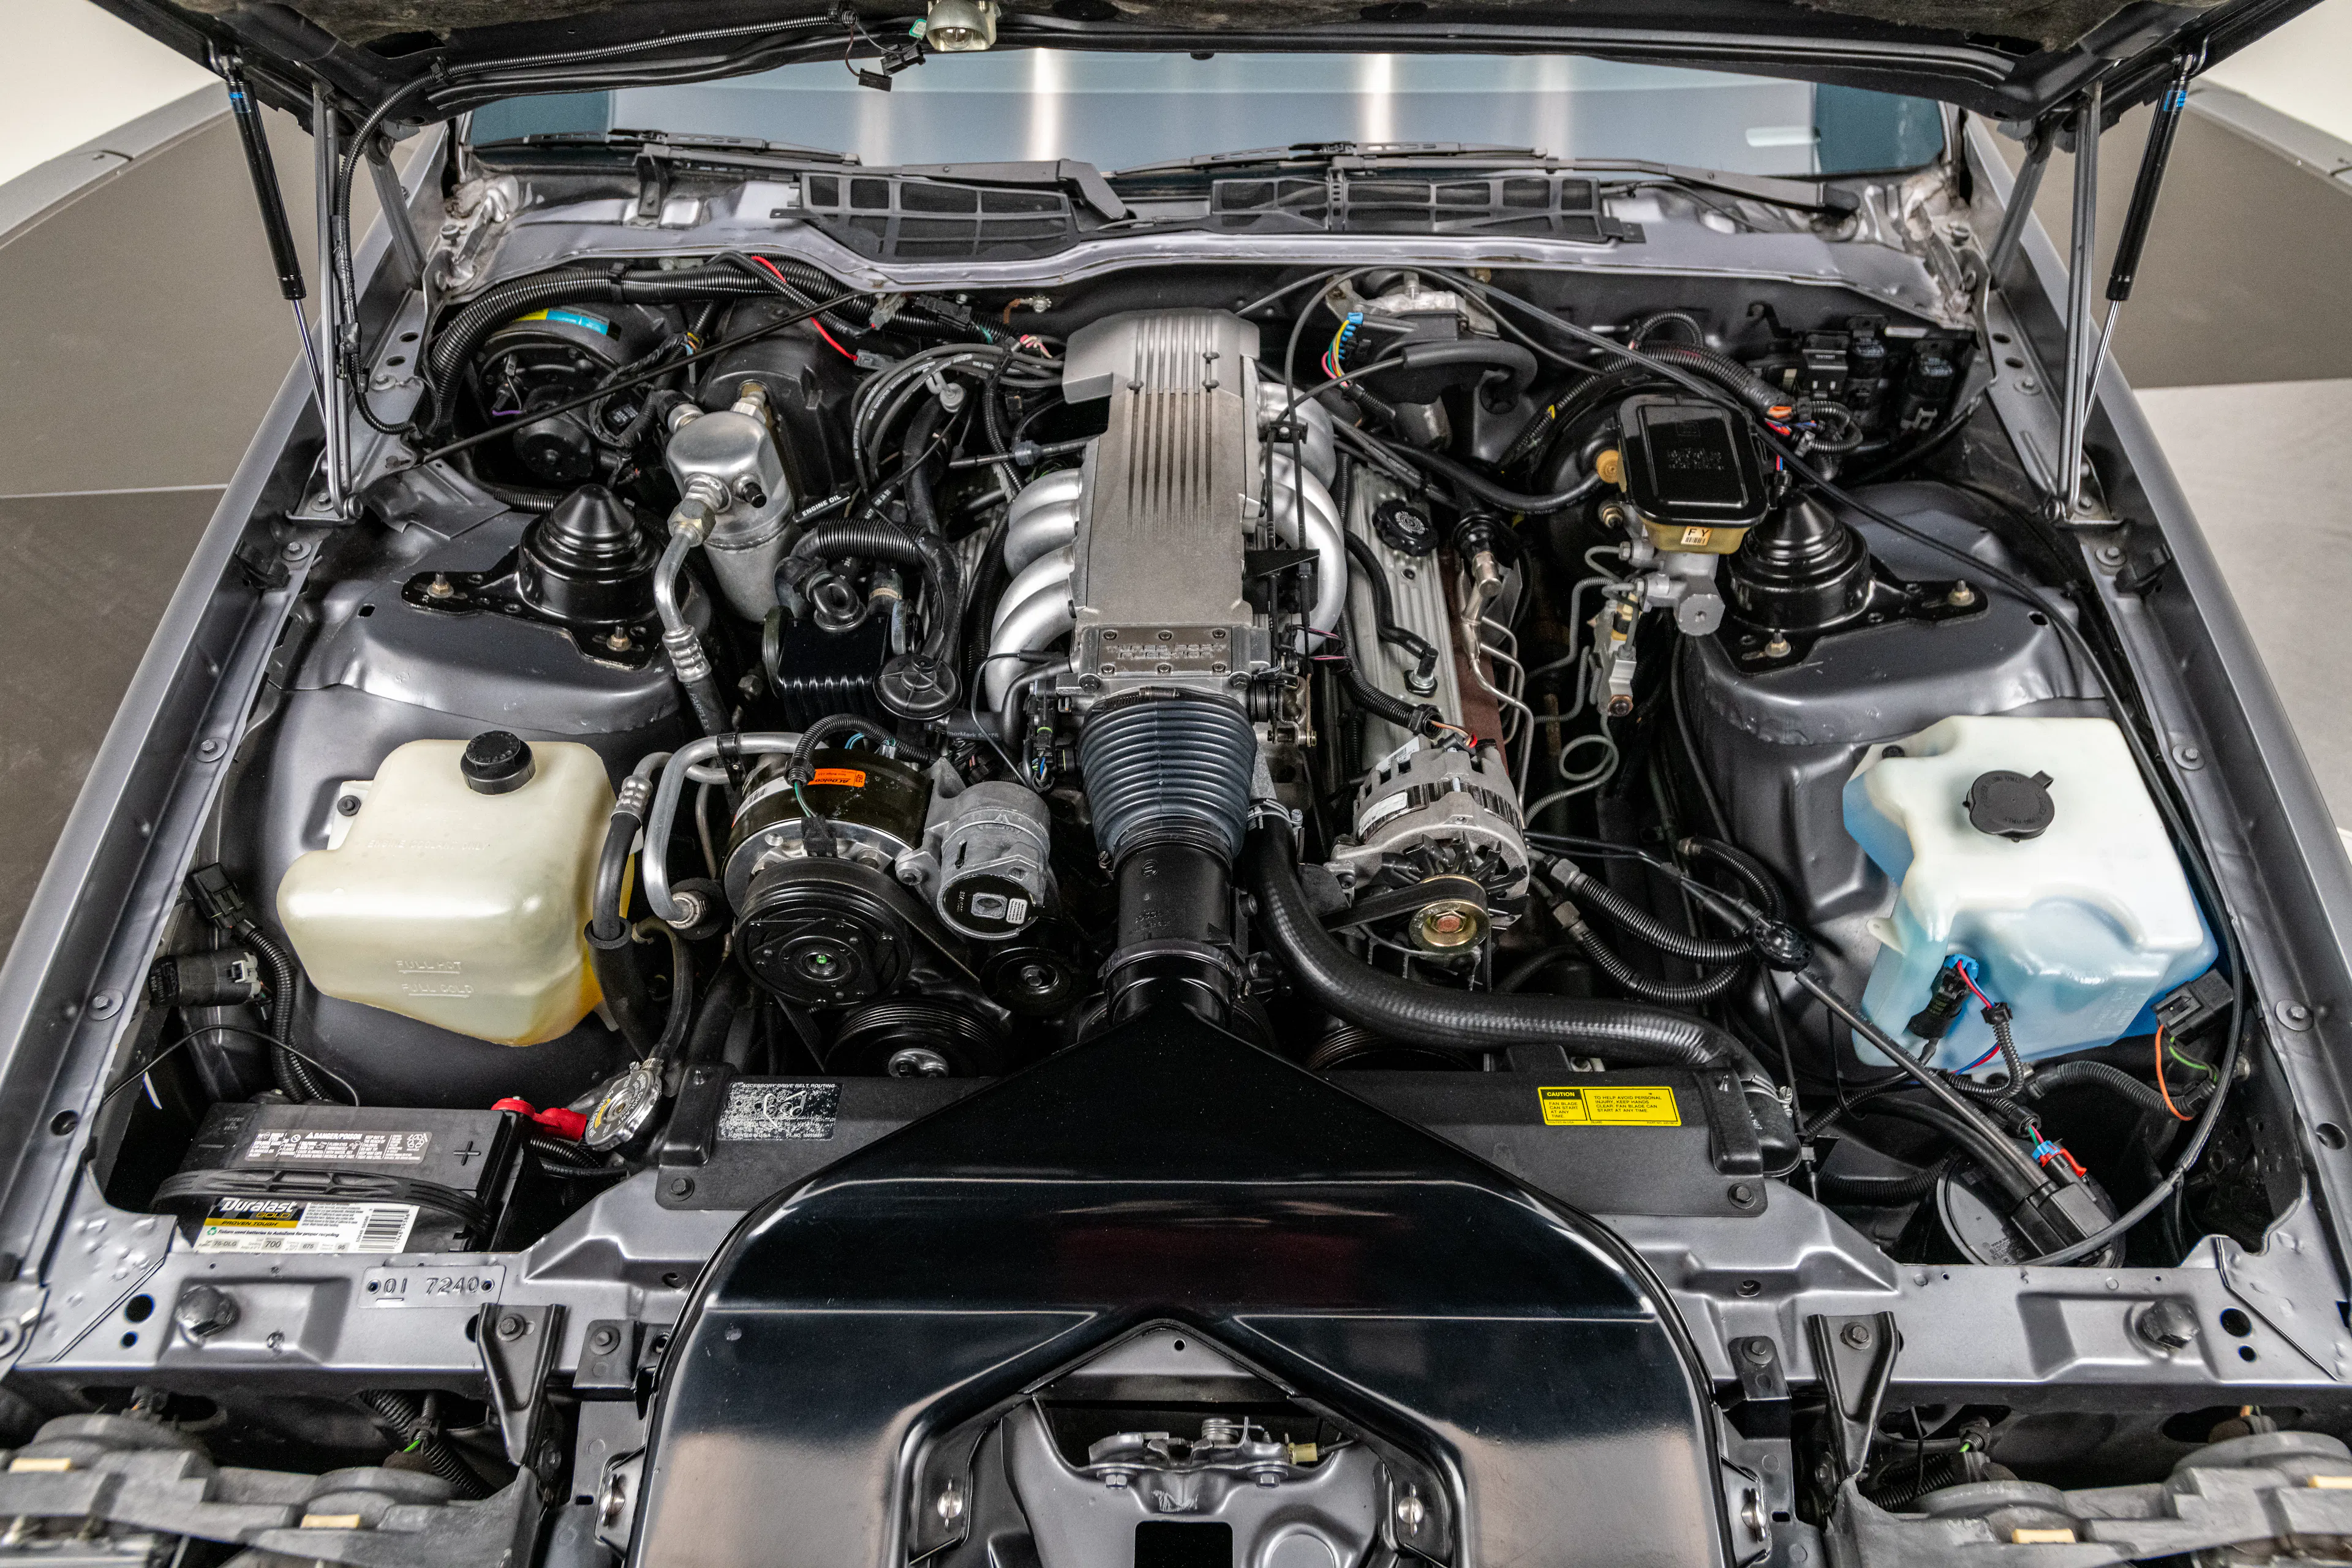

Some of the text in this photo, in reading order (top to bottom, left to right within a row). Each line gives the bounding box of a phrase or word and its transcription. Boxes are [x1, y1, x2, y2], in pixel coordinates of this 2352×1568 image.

[802, 495, 842, 517] ENGINE OIL
[368, 840, 406, 848] ENGINE
[396, 960, 461, 970] FULL HOT
[402, 984, 474, 993] FULL COLD
[637, 1074, 647, 1091] ENGINE
[595, 1090, 614, 1112] NEVER
[617, 1091, 643, 1126] COOLANT
[220, 1197, 297, 1213] Duralast
[383, 1276, 480, 1295] 01 7240
